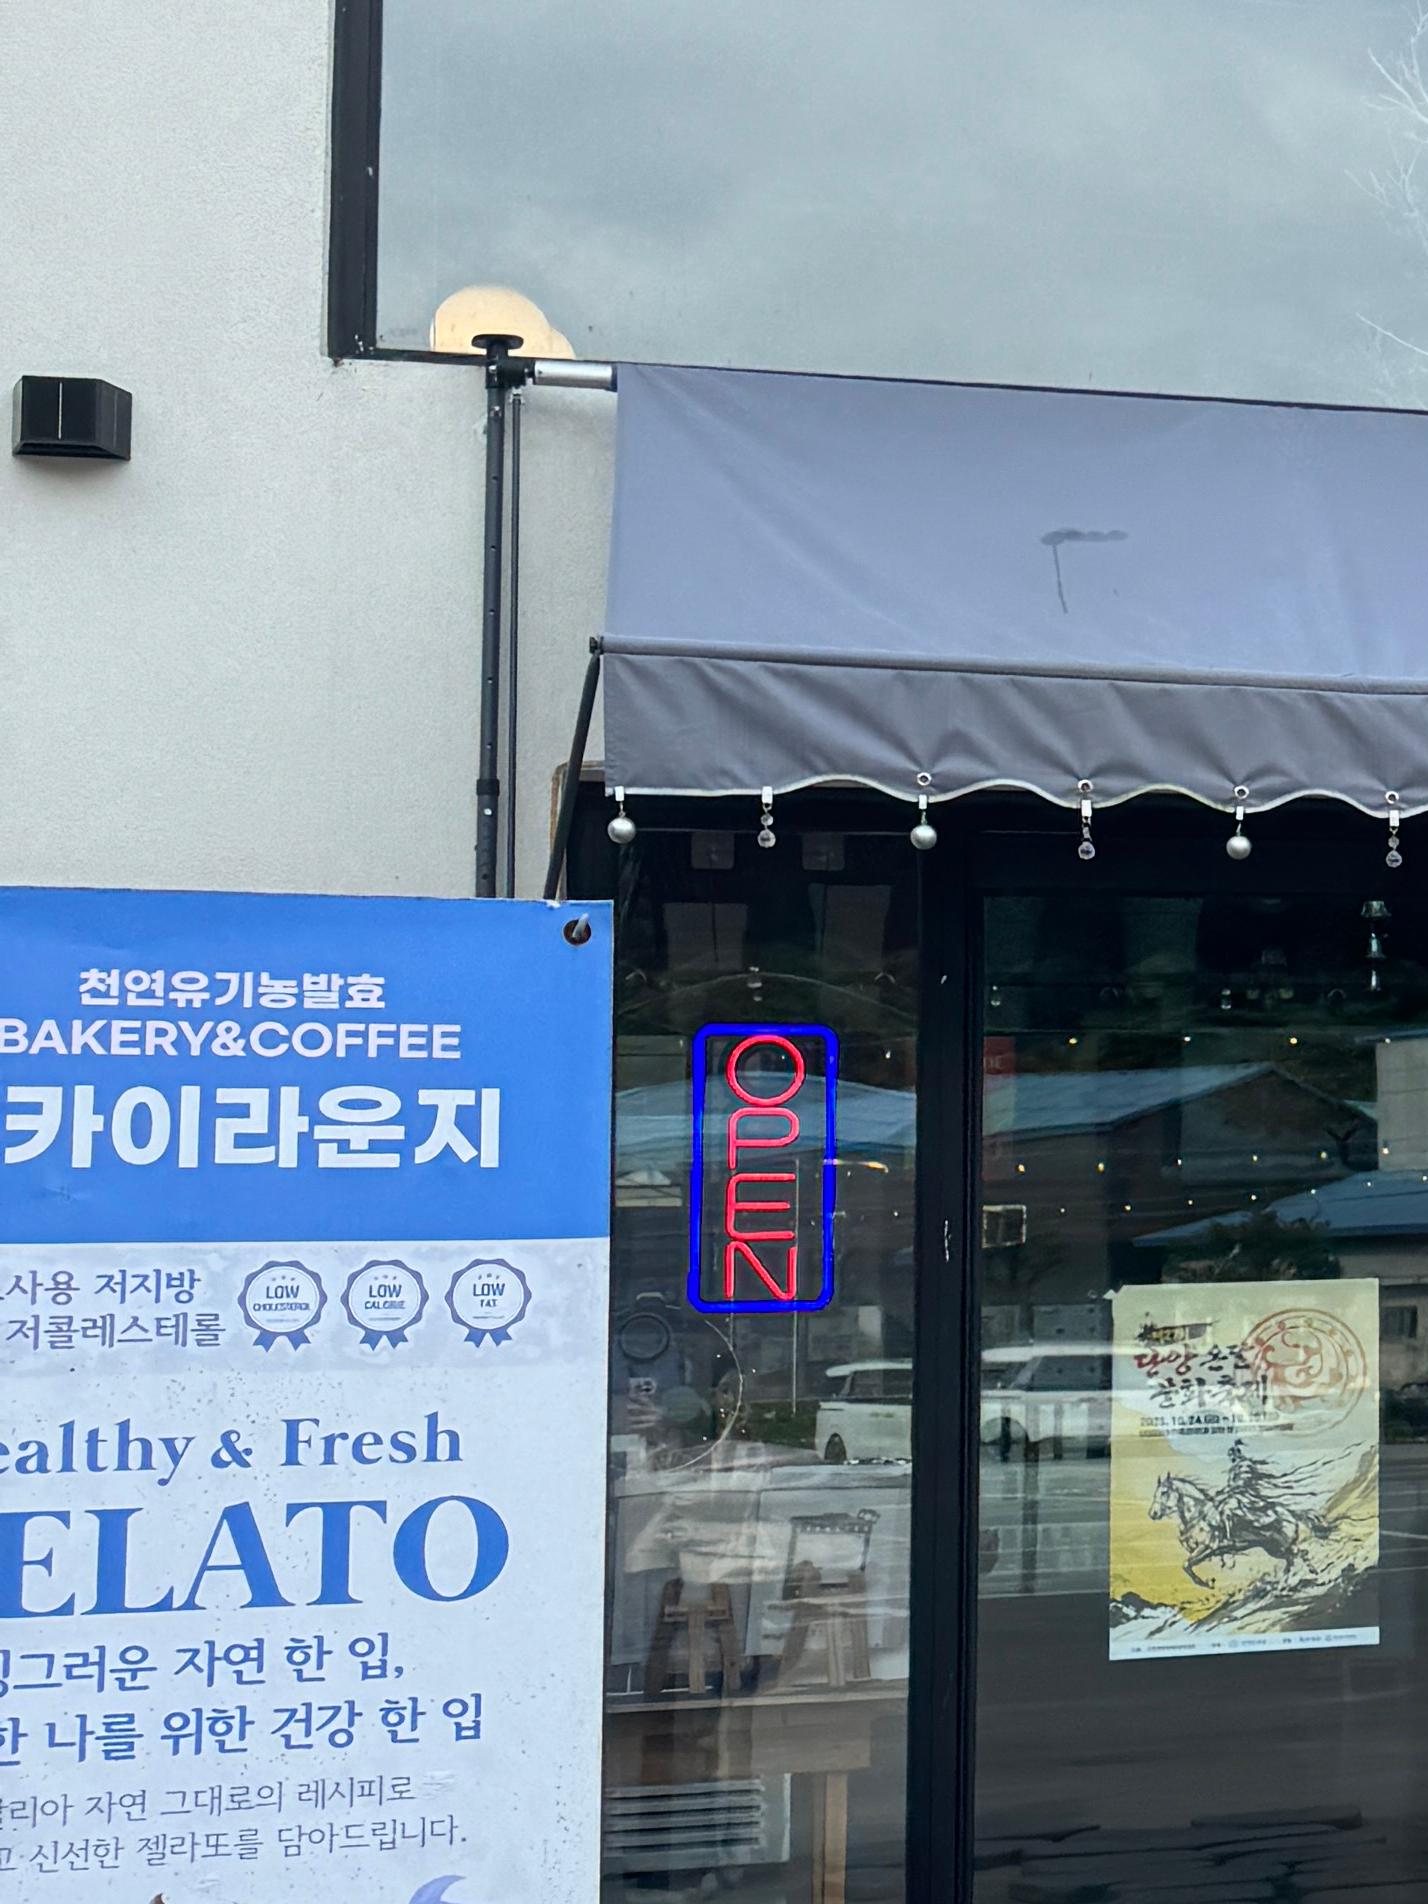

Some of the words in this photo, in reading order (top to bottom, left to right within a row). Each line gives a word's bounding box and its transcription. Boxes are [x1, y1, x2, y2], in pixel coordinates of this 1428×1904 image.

[79, 968, 386, 1009] 천연유기농발효
[0, 1017, 462, 1059] BAKERY&COFFEE
[4, 1084, 500, 1168] 카이라운지
[724, 1034, 806, 1302] OPEN
[5, 1270, 80, 1306] 사용
[94, 1269, 201, 1305] 저지방
[265, 1284, 300, 1299] LOW
[368, 1284, 402, 1298] LOW
[472, 1283, 506, 1297] LOW
[479, 1298, 499, 1308] FAT
[5, 1311, 227, 1351] 저콜레스테롤
[210, 1428, 254, 1469] &
[279, 1410, 465, 1468] Fresh
[0, 1494, 511, 1621] ELATO
[173, 1637, 267, 1689] 자연
[284, 1636, 333, 1683] 한
[347, 1632, 404, 1680] 입,
[45, 1712, 145, 1763] 나를
[160, 1705, 256, 1758] 위한
[271, 1700, 364, 1750] 건강
[379, 1696, 427, 1746] 한
[441, 1692, 485, 1742] 입
[85, 1789, 147, 1825] 자연
[160, 1780, 283, 1819] 그대로의
[296, 1774, 416, 1813] 레시피로
[29, 1836, 125, 1874] 신선한
[136, 1826, 264, 1866] 젤라또를
[277, 1813, 468, 1858] 담아드립니다.
